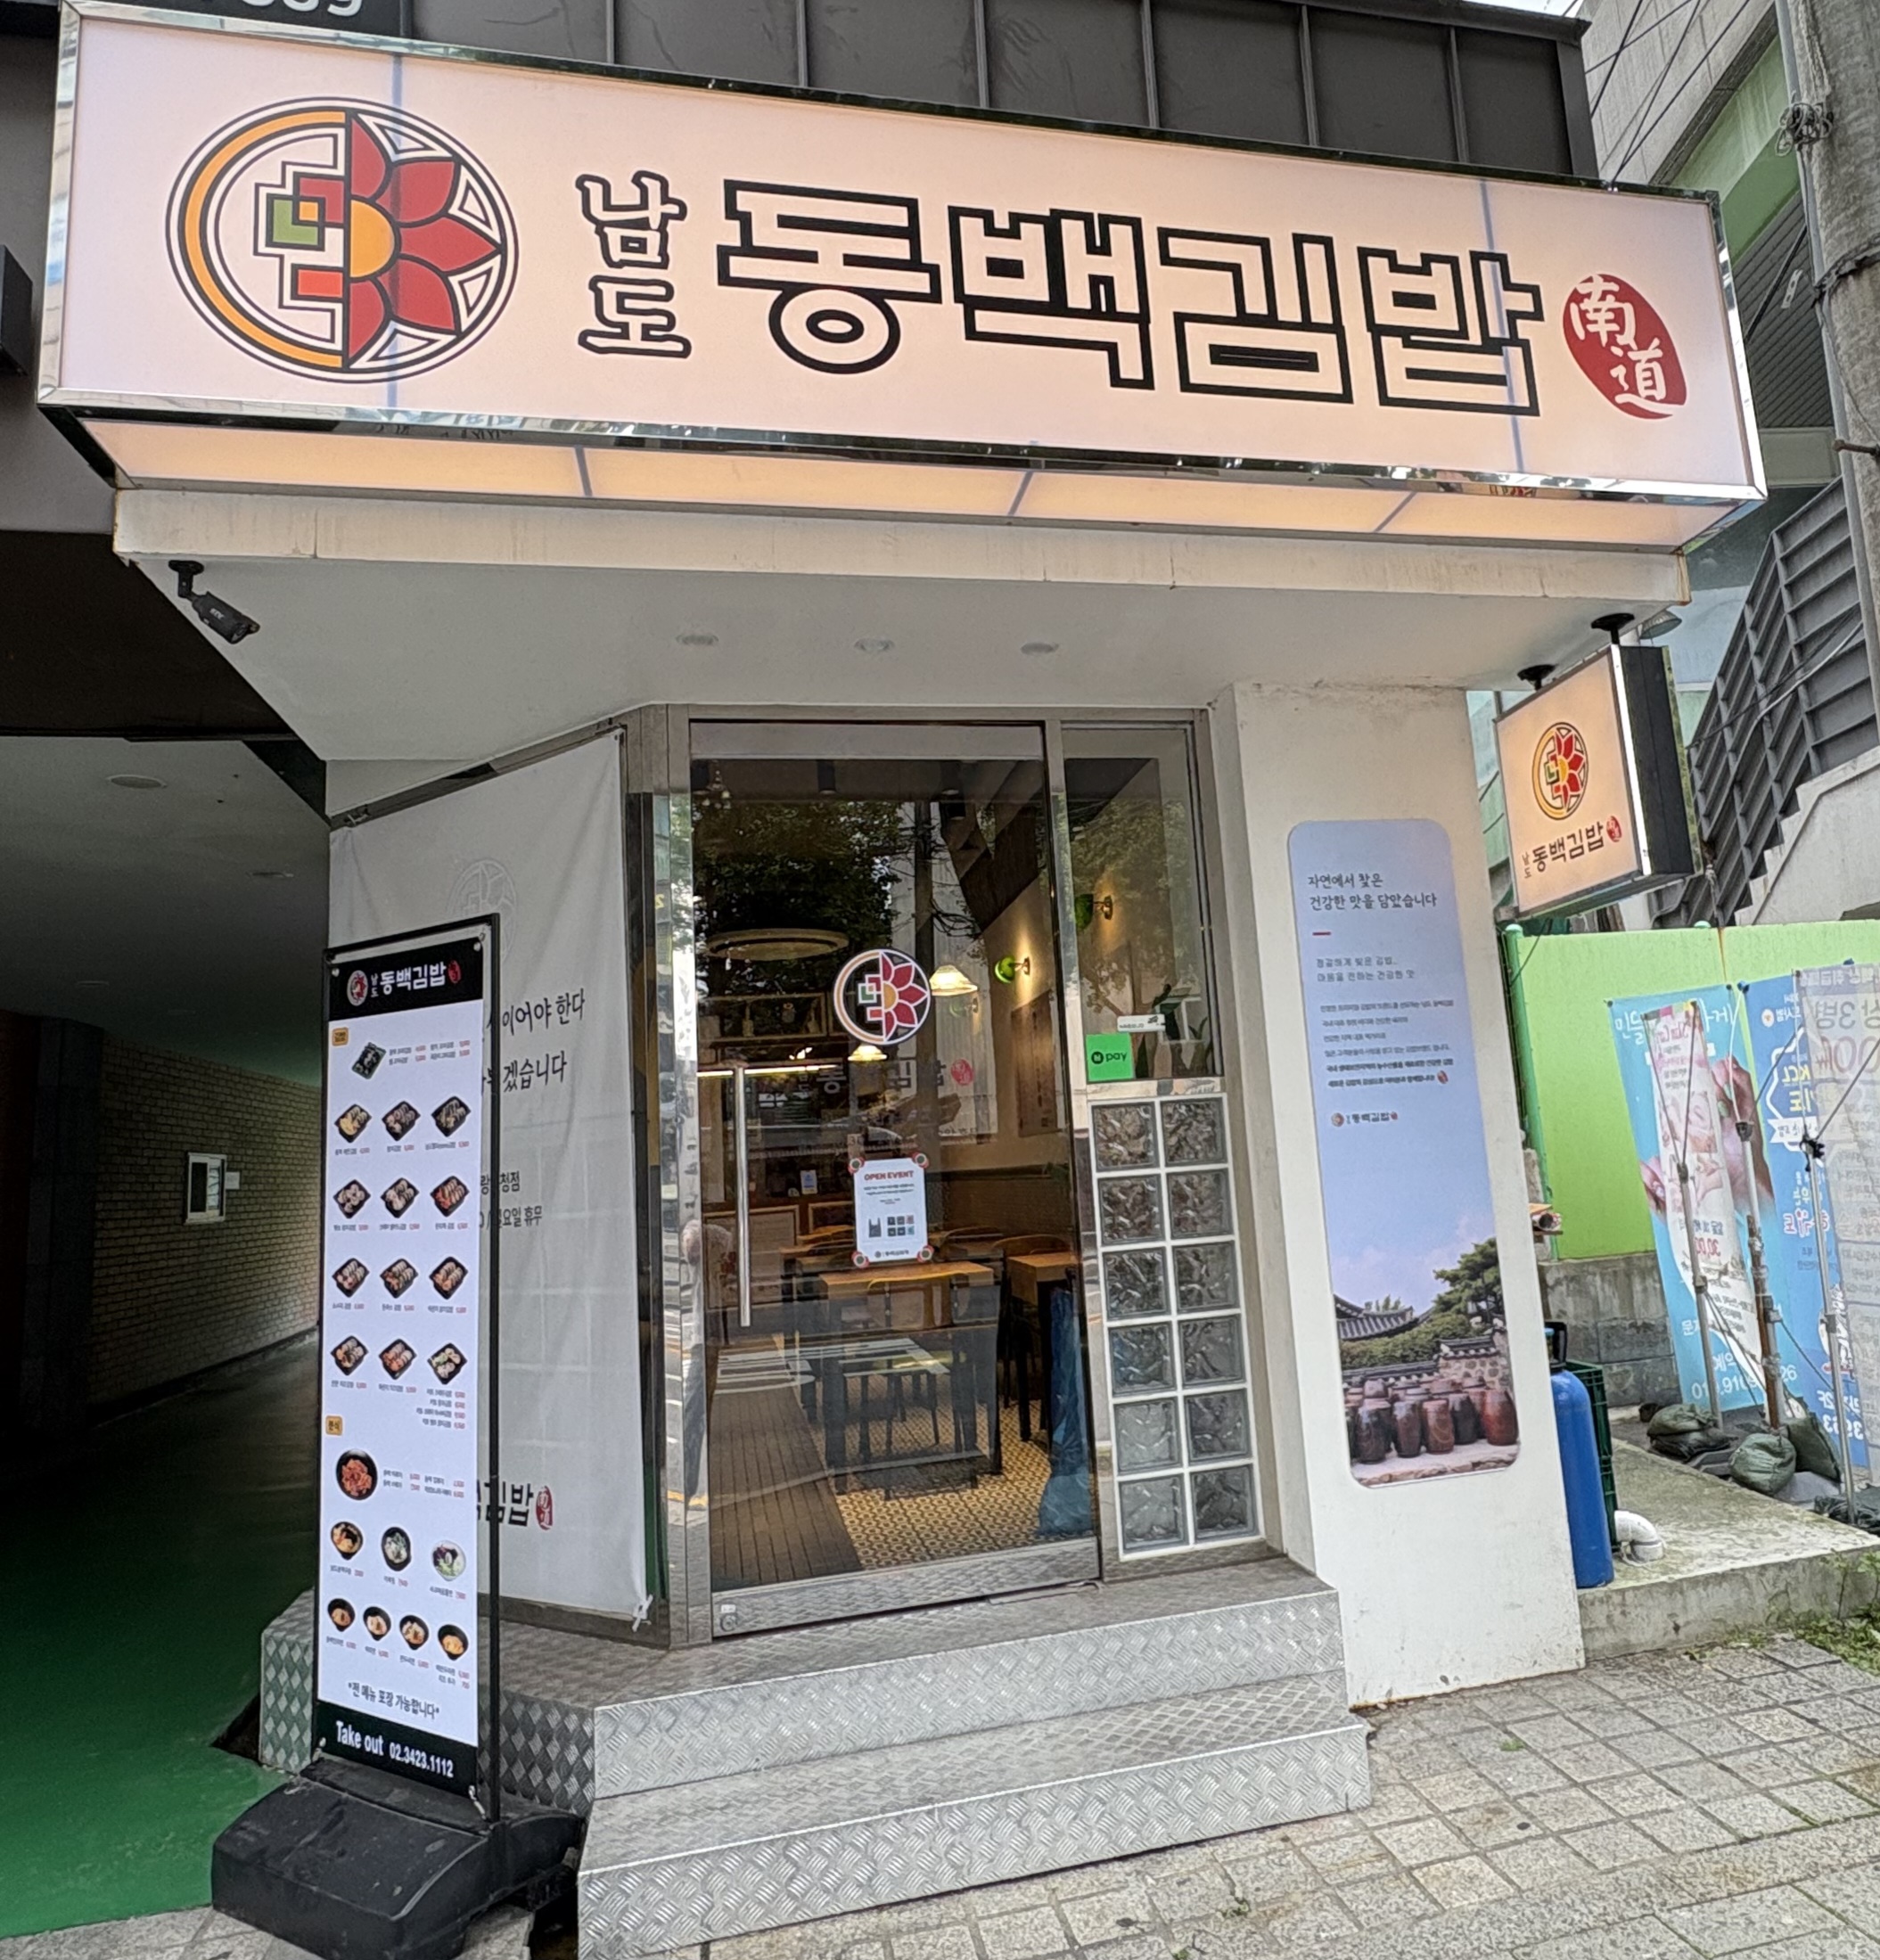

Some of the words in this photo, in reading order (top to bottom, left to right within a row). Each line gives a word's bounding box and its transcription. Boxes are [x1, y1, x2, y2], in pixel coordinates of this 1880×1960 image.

[574, 169, 693, 359] 남도
[716, 178, 1545, 417] 동백김밥
[1569, 275, 1686, 415] 南道
[1532, 820, 1605, 873] 동백김밥
[1308, 873, 1356, 889] 자연에서
[1359, 872, 1383, 888] 찾은
[1309, 895, 1346, 911] 건강한
[1349, 894, 1375, 910] 맛을
[1377, 892, 1437, 909] 담았습니다
[380, 961, 447, 996] 동백김밥
[487, 996, 553, 1036] 이어야
[555, 987, 586, 1025] 한다
[1105, 1053, 1128, 1062] pay
[864, 1172, 886, 1181] OPEN
[887, 1170, 915, 1180] EVENT
[524, 1205, 543, 1227] 휴무
[477, 1480, 534, 1527] 김밥
[361, 1684, 376, 1702] 메뉴
[378, 1690, 394, 1708] 포장
[335, 1719, 362, 1749] Take
[364, 1734, 384, 1756] out
[389, 1742, 455, 1778] 02.3423.1112
